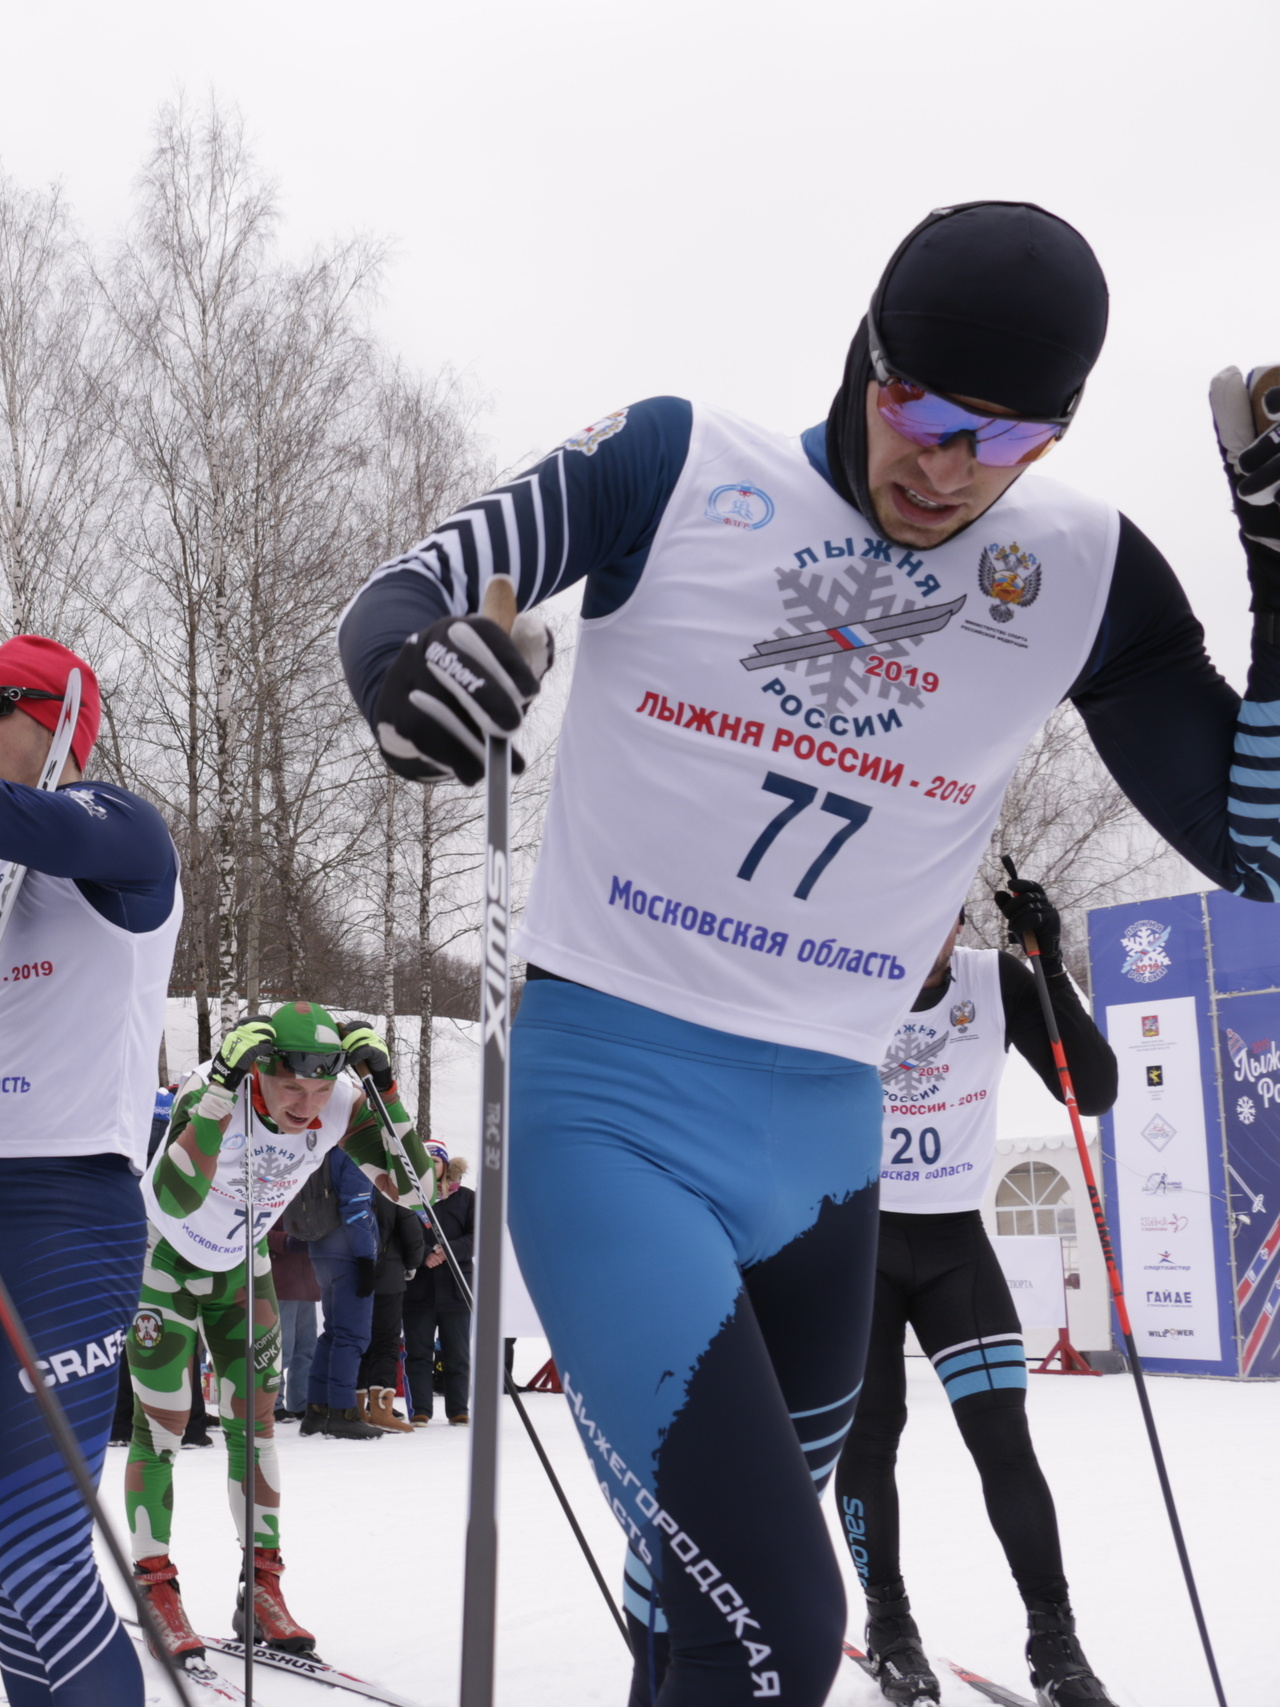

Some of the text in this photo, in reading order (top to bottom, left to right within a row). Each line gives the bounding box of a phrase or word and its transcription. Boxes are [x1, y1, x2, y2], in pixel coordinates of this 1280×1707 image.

[793, 537, 941, 597] ЛЫЖНЯ
[865, 655, 940, 692] 2019
[761, 677, 903, 737] РОССИИ
[636, 691, 765, 747] ЛЫЖНЯ
[772, 727, 904, 787] РОССИИ
[924, 775, 977, 805] 2019
[736, 770, 873, 900] 77
[608, 875, 906, 980] Московская область
[1124, 920, 1165, 937] ЛЫЖНЯ
[485, 843, 508, 1064] SWIX
[1135, 963, 1160, 973] 2019
[12, 960, 54, 982] 2019
[1128, 966, 1168, 983] РОССИИ
[919, 1064, 950, 1077] 2019
[891, 1102, 946, 1115] РОССИИ
[959, 1090, 987, 1106] 2019
[254, 1144, 296, 1162] ЫЖНЯ
[890, 1126, 941, 1165] 20
[273, 1178, 298, 1188] 2019
[925, 1162, 973, 1180] область
[182, 1222, 244, 1254] Московская
[226, 1208, 272, 1240] 75
[1086, 1184, 1118, 1272] ATOMIC
[1146, 1290, 1192, 1303] ГАЙДЕ
[562, 1371, 781, 1698] НИЖЕГОРОДСКАЯ
[221, 1642, 322, 1674] MADSHUS
